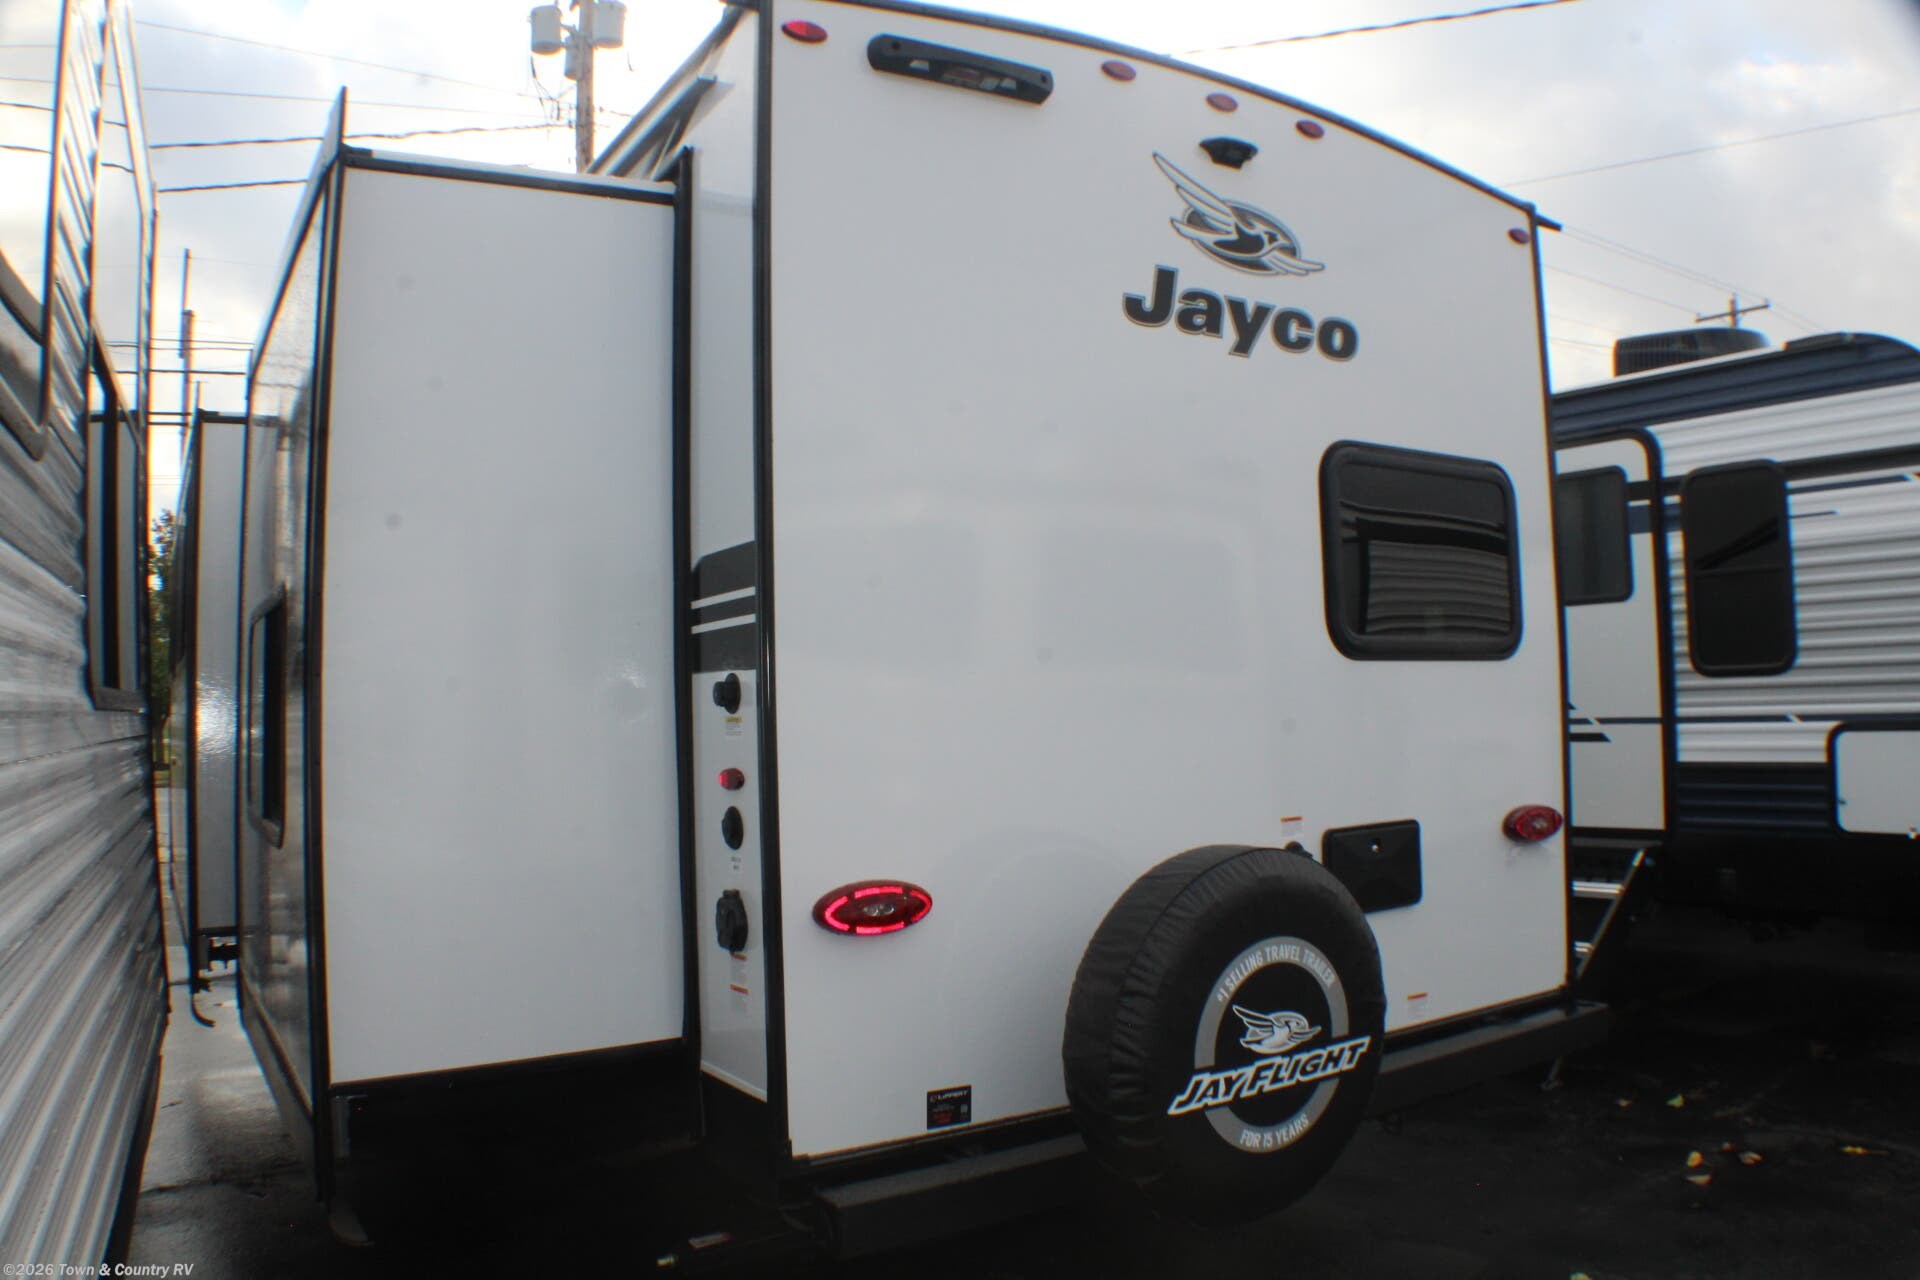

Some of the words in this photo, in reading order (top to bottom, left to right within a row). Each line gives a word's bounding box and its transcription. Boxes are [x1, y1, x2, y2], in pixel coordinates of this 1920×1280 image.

[1123, 264, 1359, 362] Jayco
[1225, 951, 1263, 988] SELLING
[1265, 944, 1301, 961] TRAVEL
[1303, 950, 1336, 987] TRAILER
[1240, 1129, 1261, 1148] FOR
[1275, 1113, 1309, 1145] YEARS
